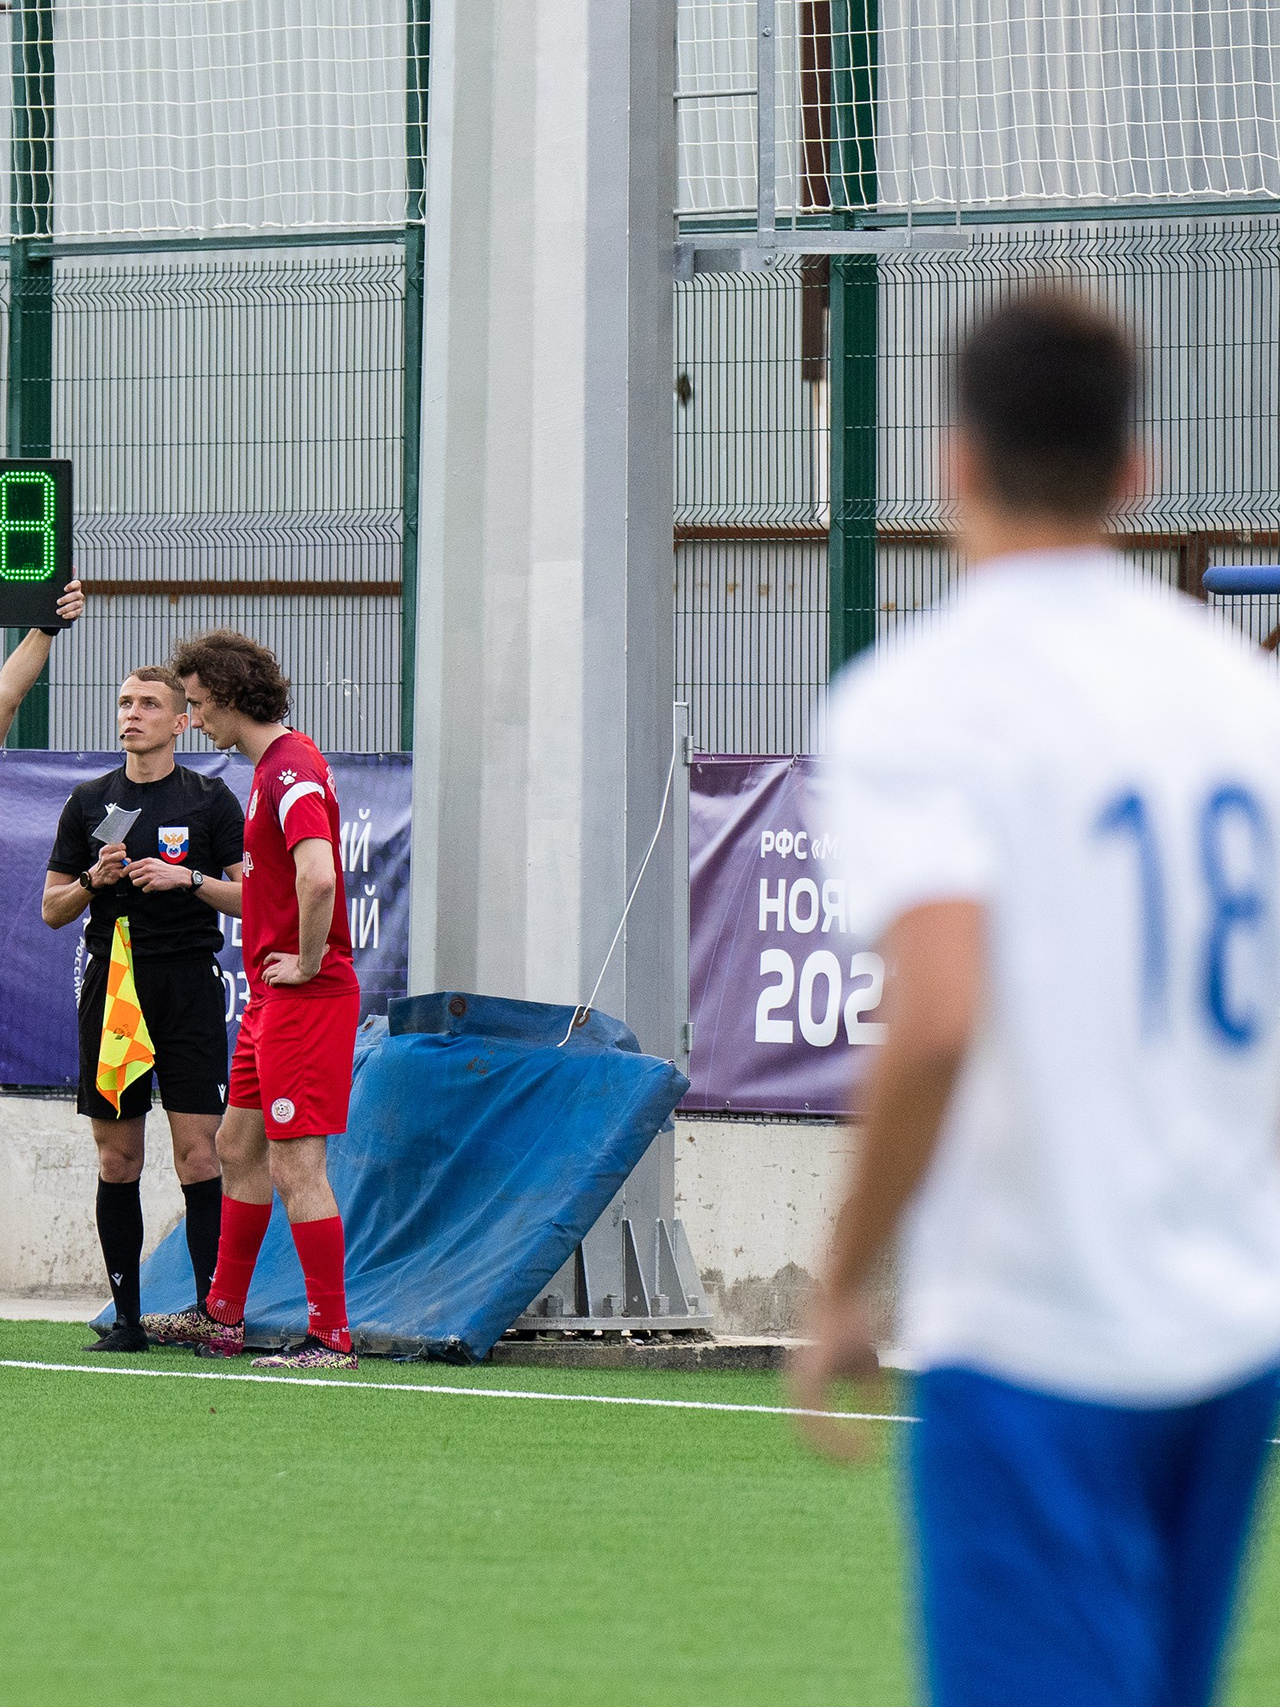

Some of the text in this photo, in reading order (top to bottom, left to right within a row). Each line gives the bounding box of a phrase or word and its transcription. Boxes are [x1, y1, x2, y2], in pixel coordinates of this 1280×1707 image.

[760, 828, 807, 860] РФС
[758, 877, 854, 934] НОЯ
[1086, 780, 1270, 1056] 18
[755, 948, 889, 1047] 202
